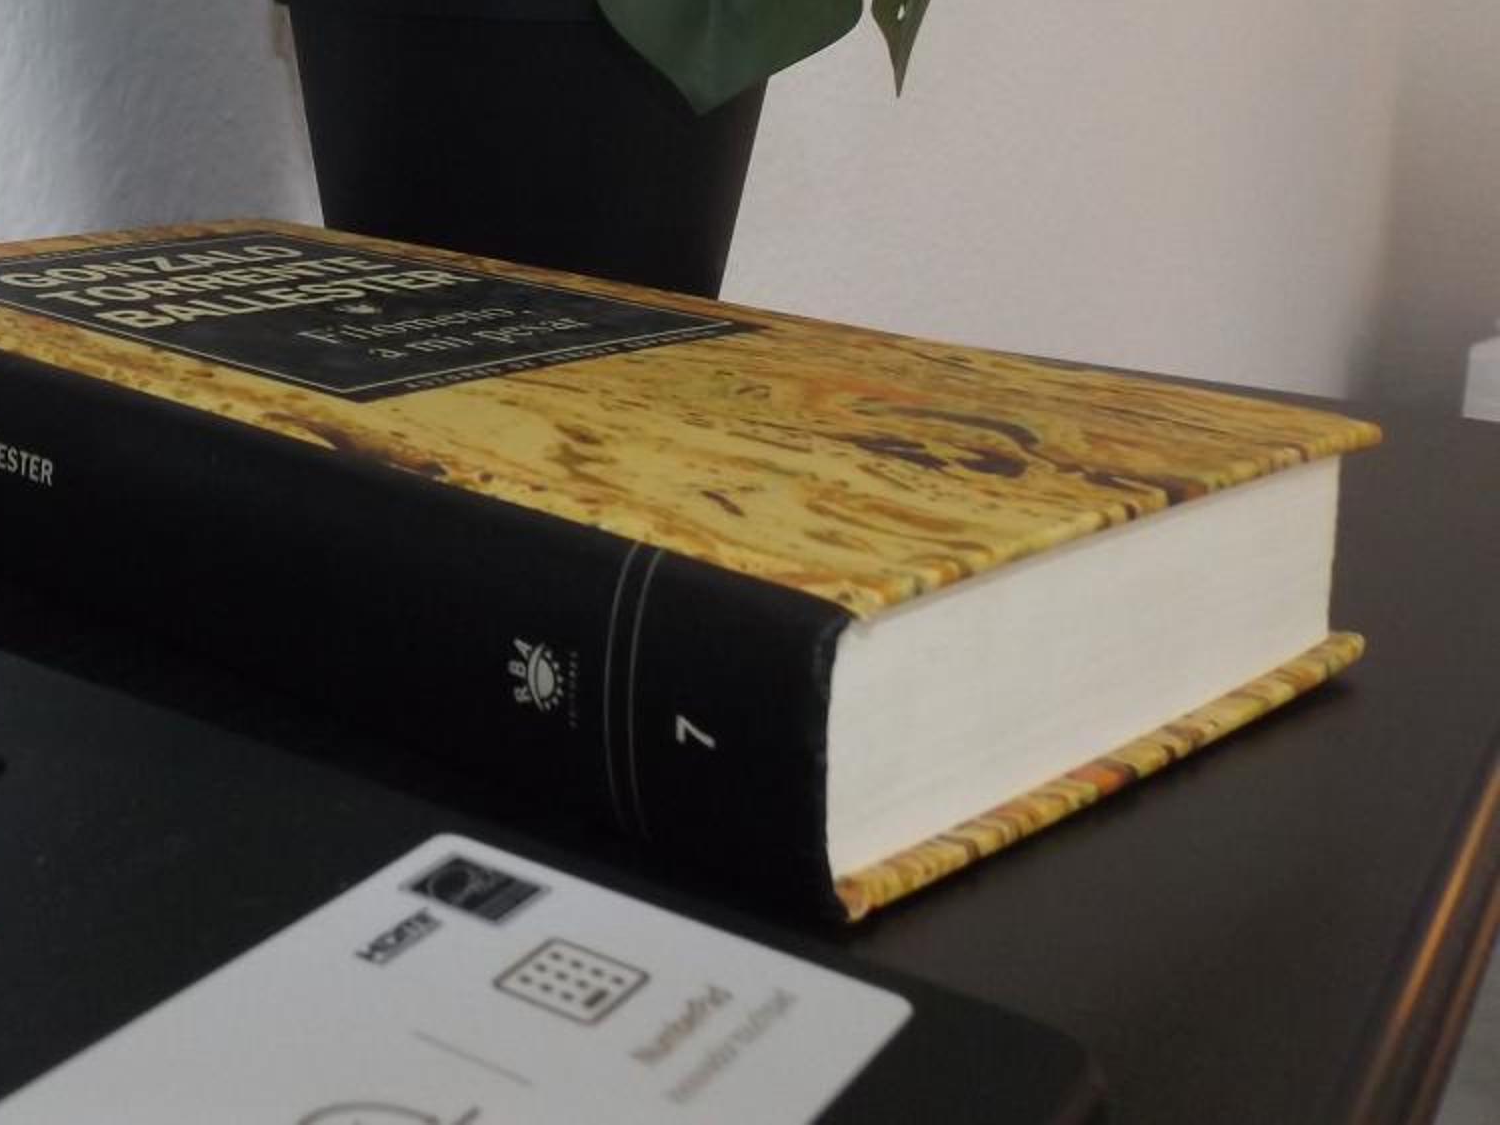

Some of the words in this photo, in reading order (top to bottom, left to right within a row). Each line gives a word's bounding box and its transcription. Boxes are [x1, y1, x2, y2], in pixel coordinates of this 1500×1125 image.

[36, 256, 396, 307] TORRENTE
[94, 270, 482, 328] BALLESTER
[296, 307, 533, 345] Filomeno,
[367, 347, 409, 360] a
[470, 317, 590, 345] pesar
[507, 636, 533, 704] RBA
[675, 714, 716, 748] 7
